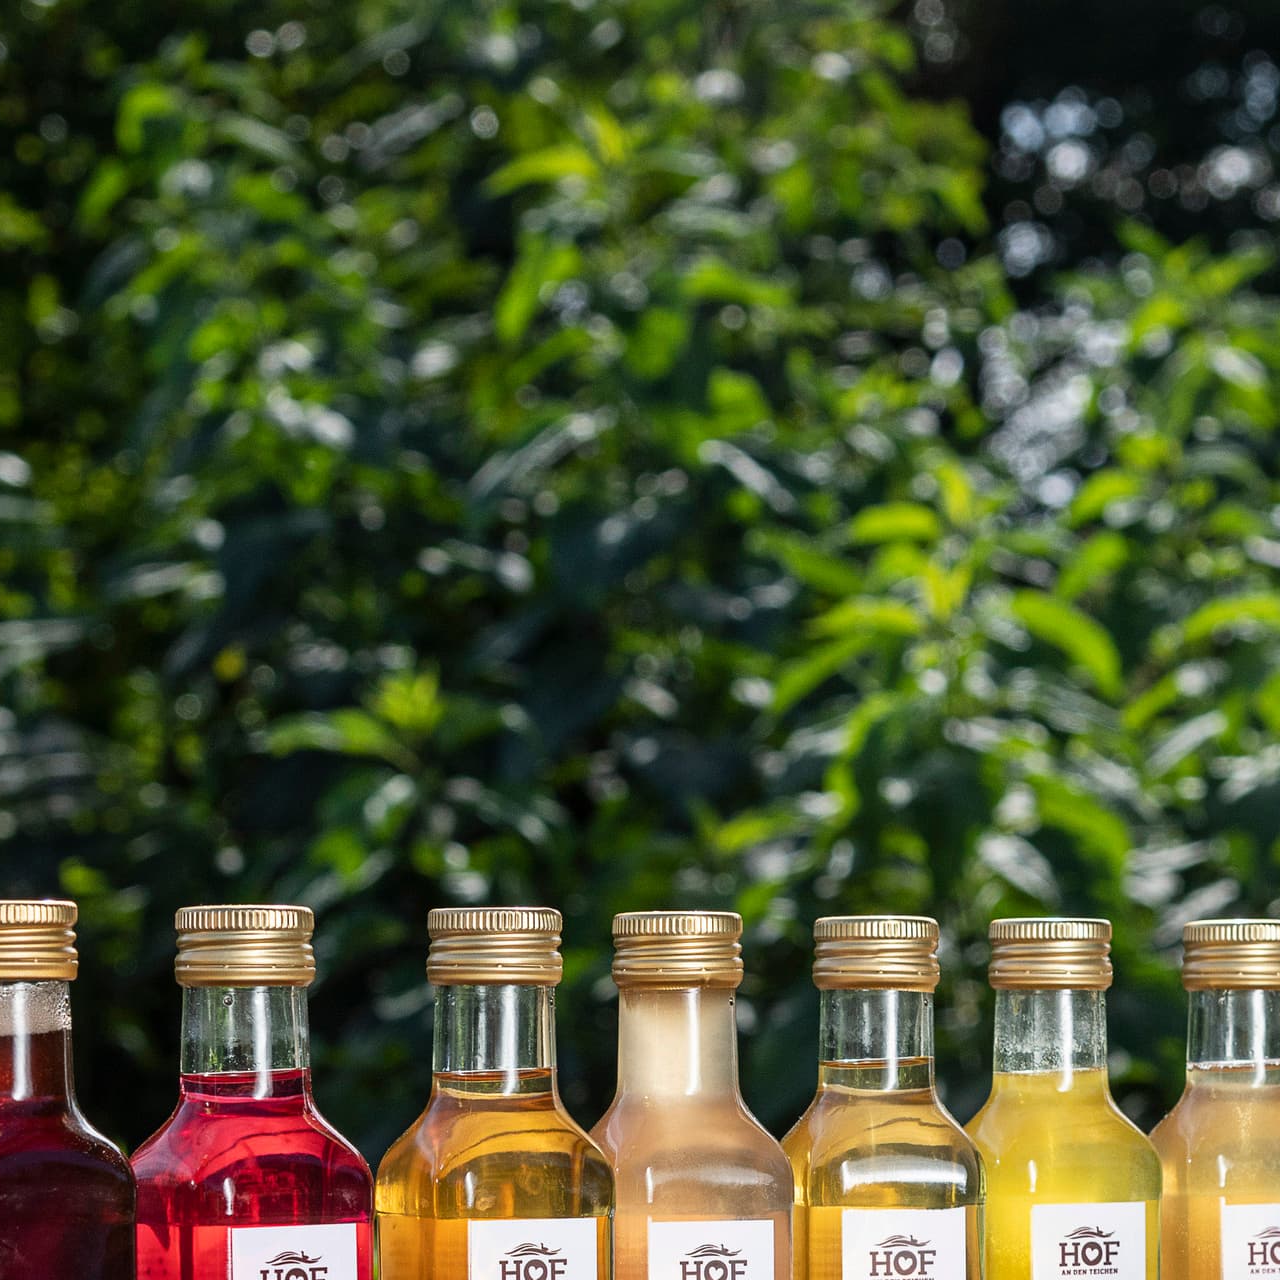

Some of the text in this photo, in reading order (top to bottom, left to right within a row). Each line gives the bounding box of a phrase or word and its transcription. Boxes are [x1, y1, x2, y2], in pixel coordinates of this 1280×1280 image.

[869, 1249, 937, 1277] HOF
[1059, 1240, 1121, 1266] HOF
[1061, 1268, 1072, 1276] AN
[1090, 1267, 1119, 1275] TEICHEN
